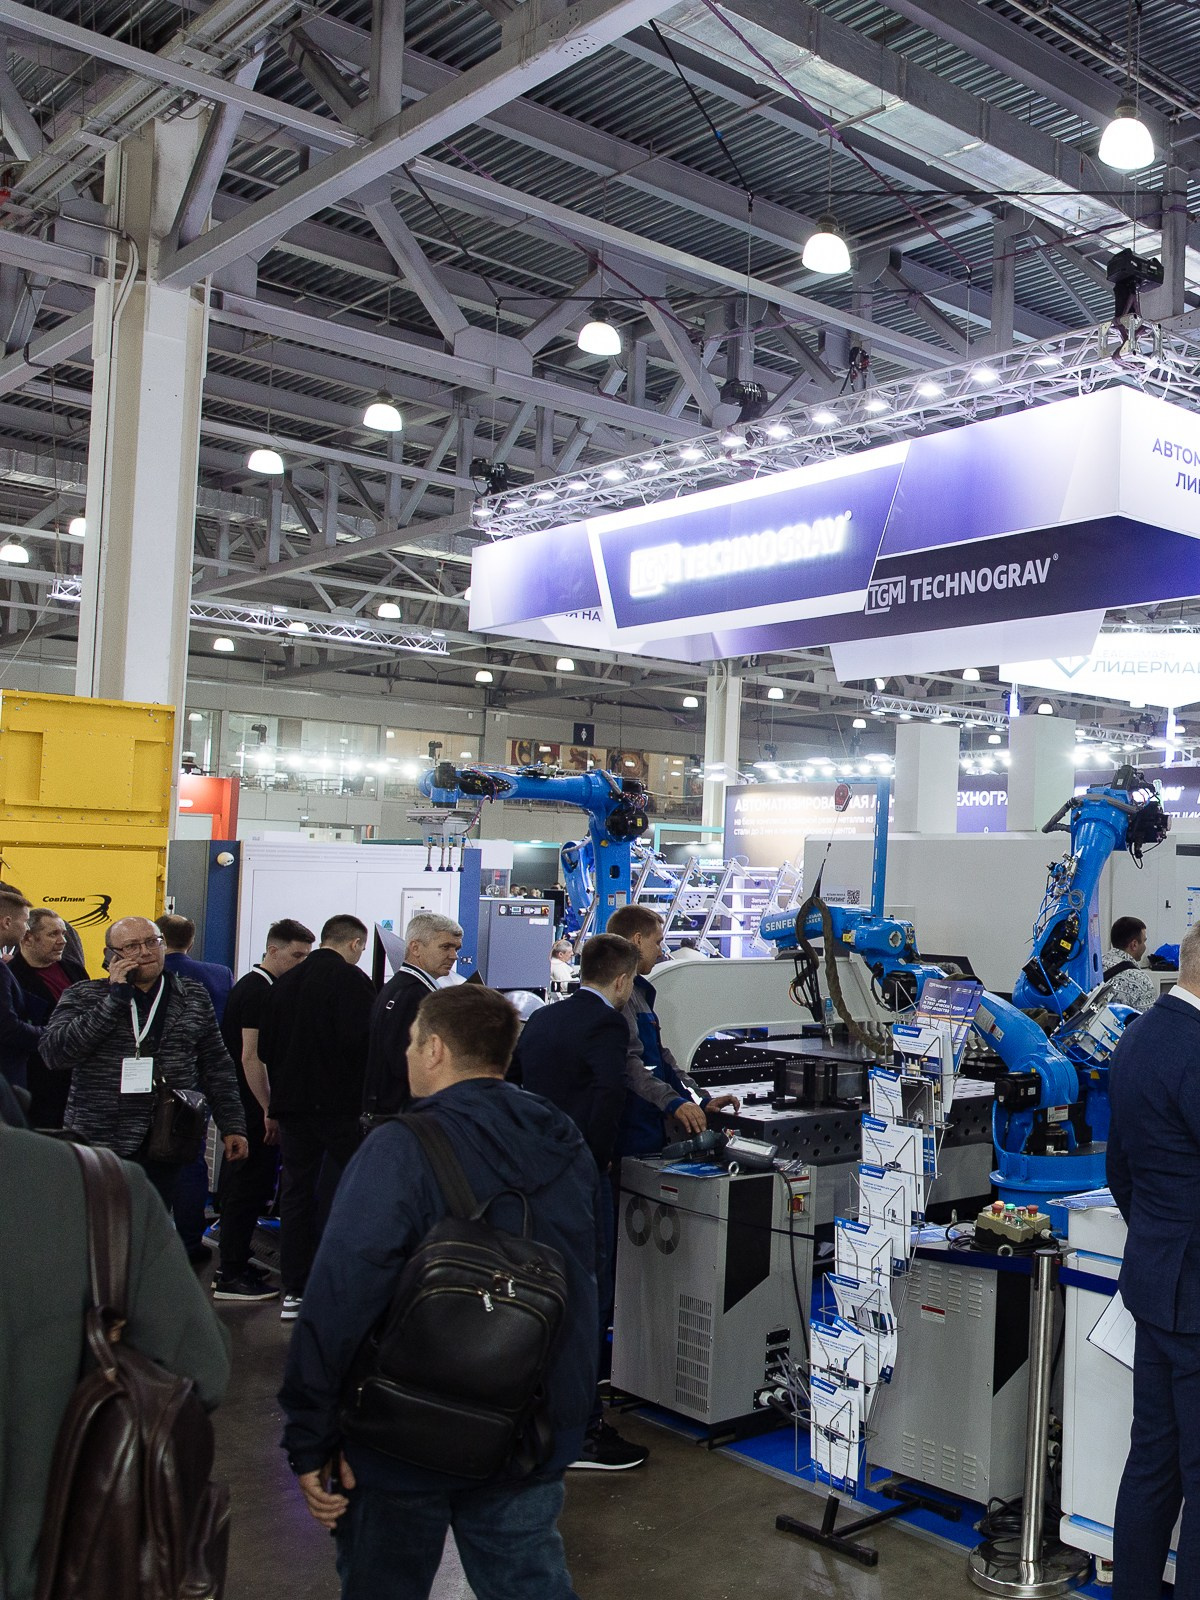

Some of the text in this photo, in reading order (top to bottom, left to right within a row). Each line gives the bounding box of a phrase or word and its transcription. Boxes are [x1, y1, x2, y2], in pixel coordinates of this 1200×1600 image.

[632, 516, 844, 595] TGM TECHNOGRAV
[867, 557, 1051, 612] TGM TECHNOGRAV
[582, 610, 601, 622] НА
[765, 917, 797, 932] SENFEN
